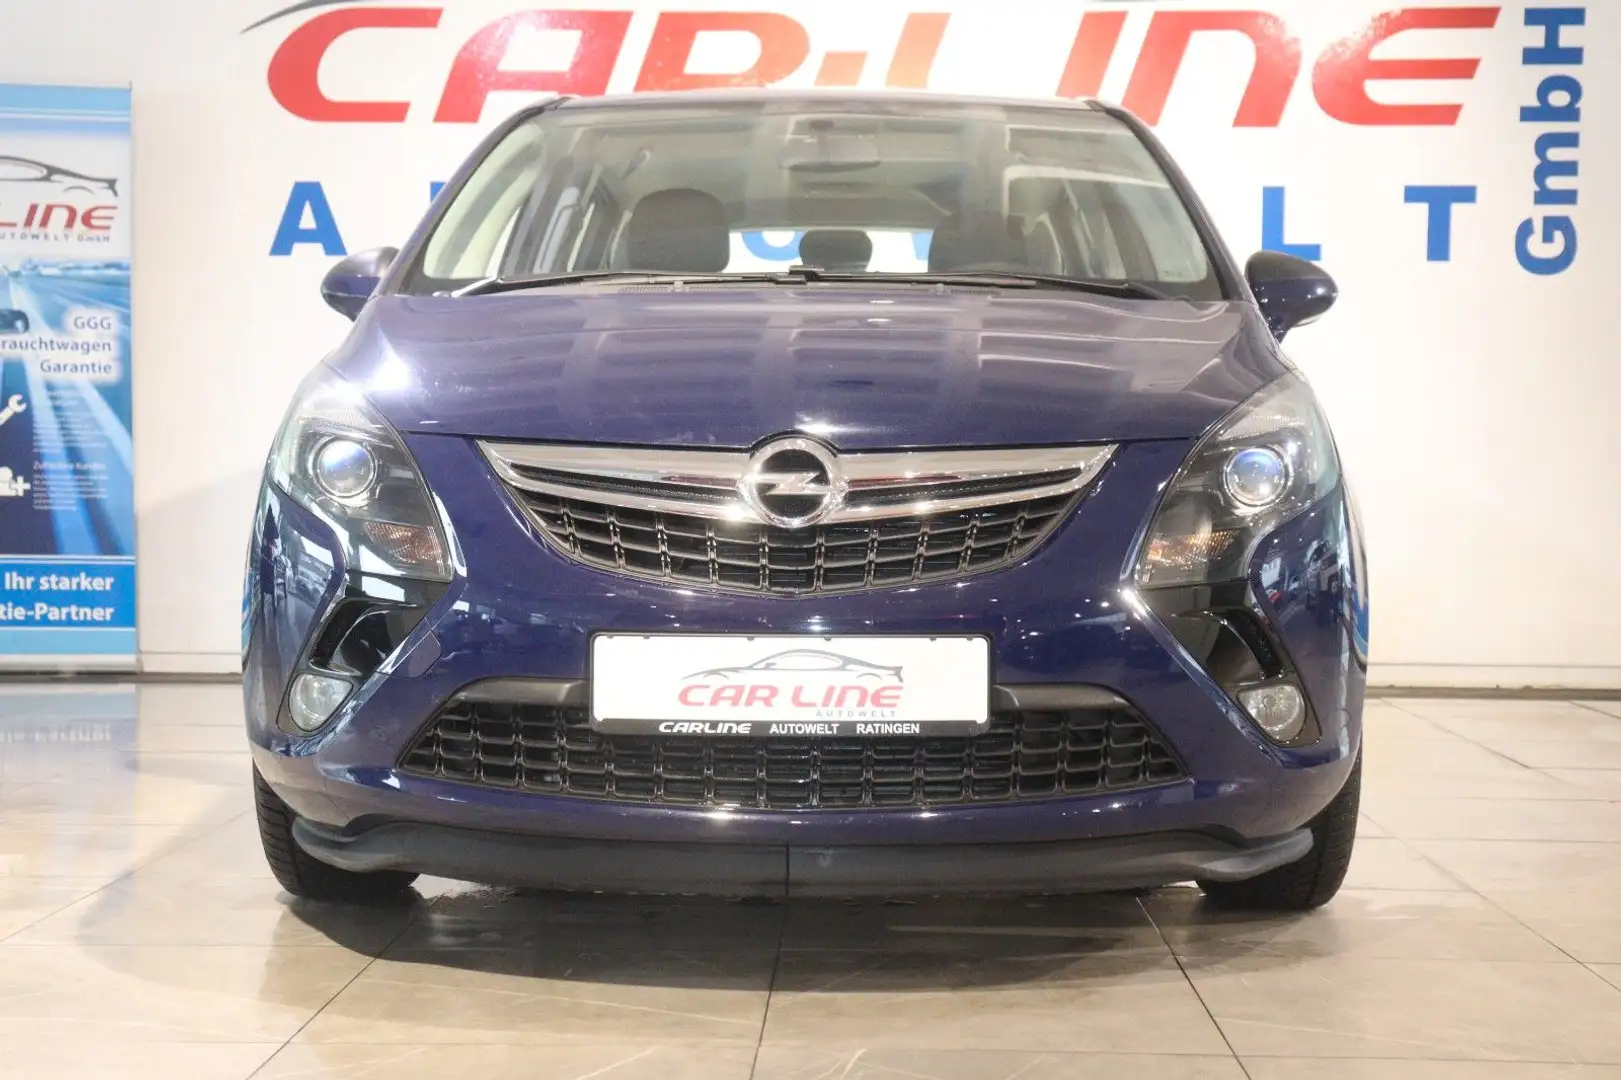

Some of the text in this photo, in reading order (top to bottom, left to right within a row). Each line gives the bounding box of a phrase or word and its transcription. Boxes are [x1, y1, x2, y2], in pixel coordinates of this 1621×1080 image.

[1515, 8, 1586, 276] GmbH
[73, 316, 111, 330] GGG
[1, 336, 111, 354] rauchtwagen
[40, 359, 112, 374] Garantie
[4, 572, 114, 591] Ihr starker
[678, 684, 904, 708] CAR LINE
[816, 710, 896, 718] AUTOWELT
[658, 722, 920, 734] CARLINE AUTOWELT RATINGEN
